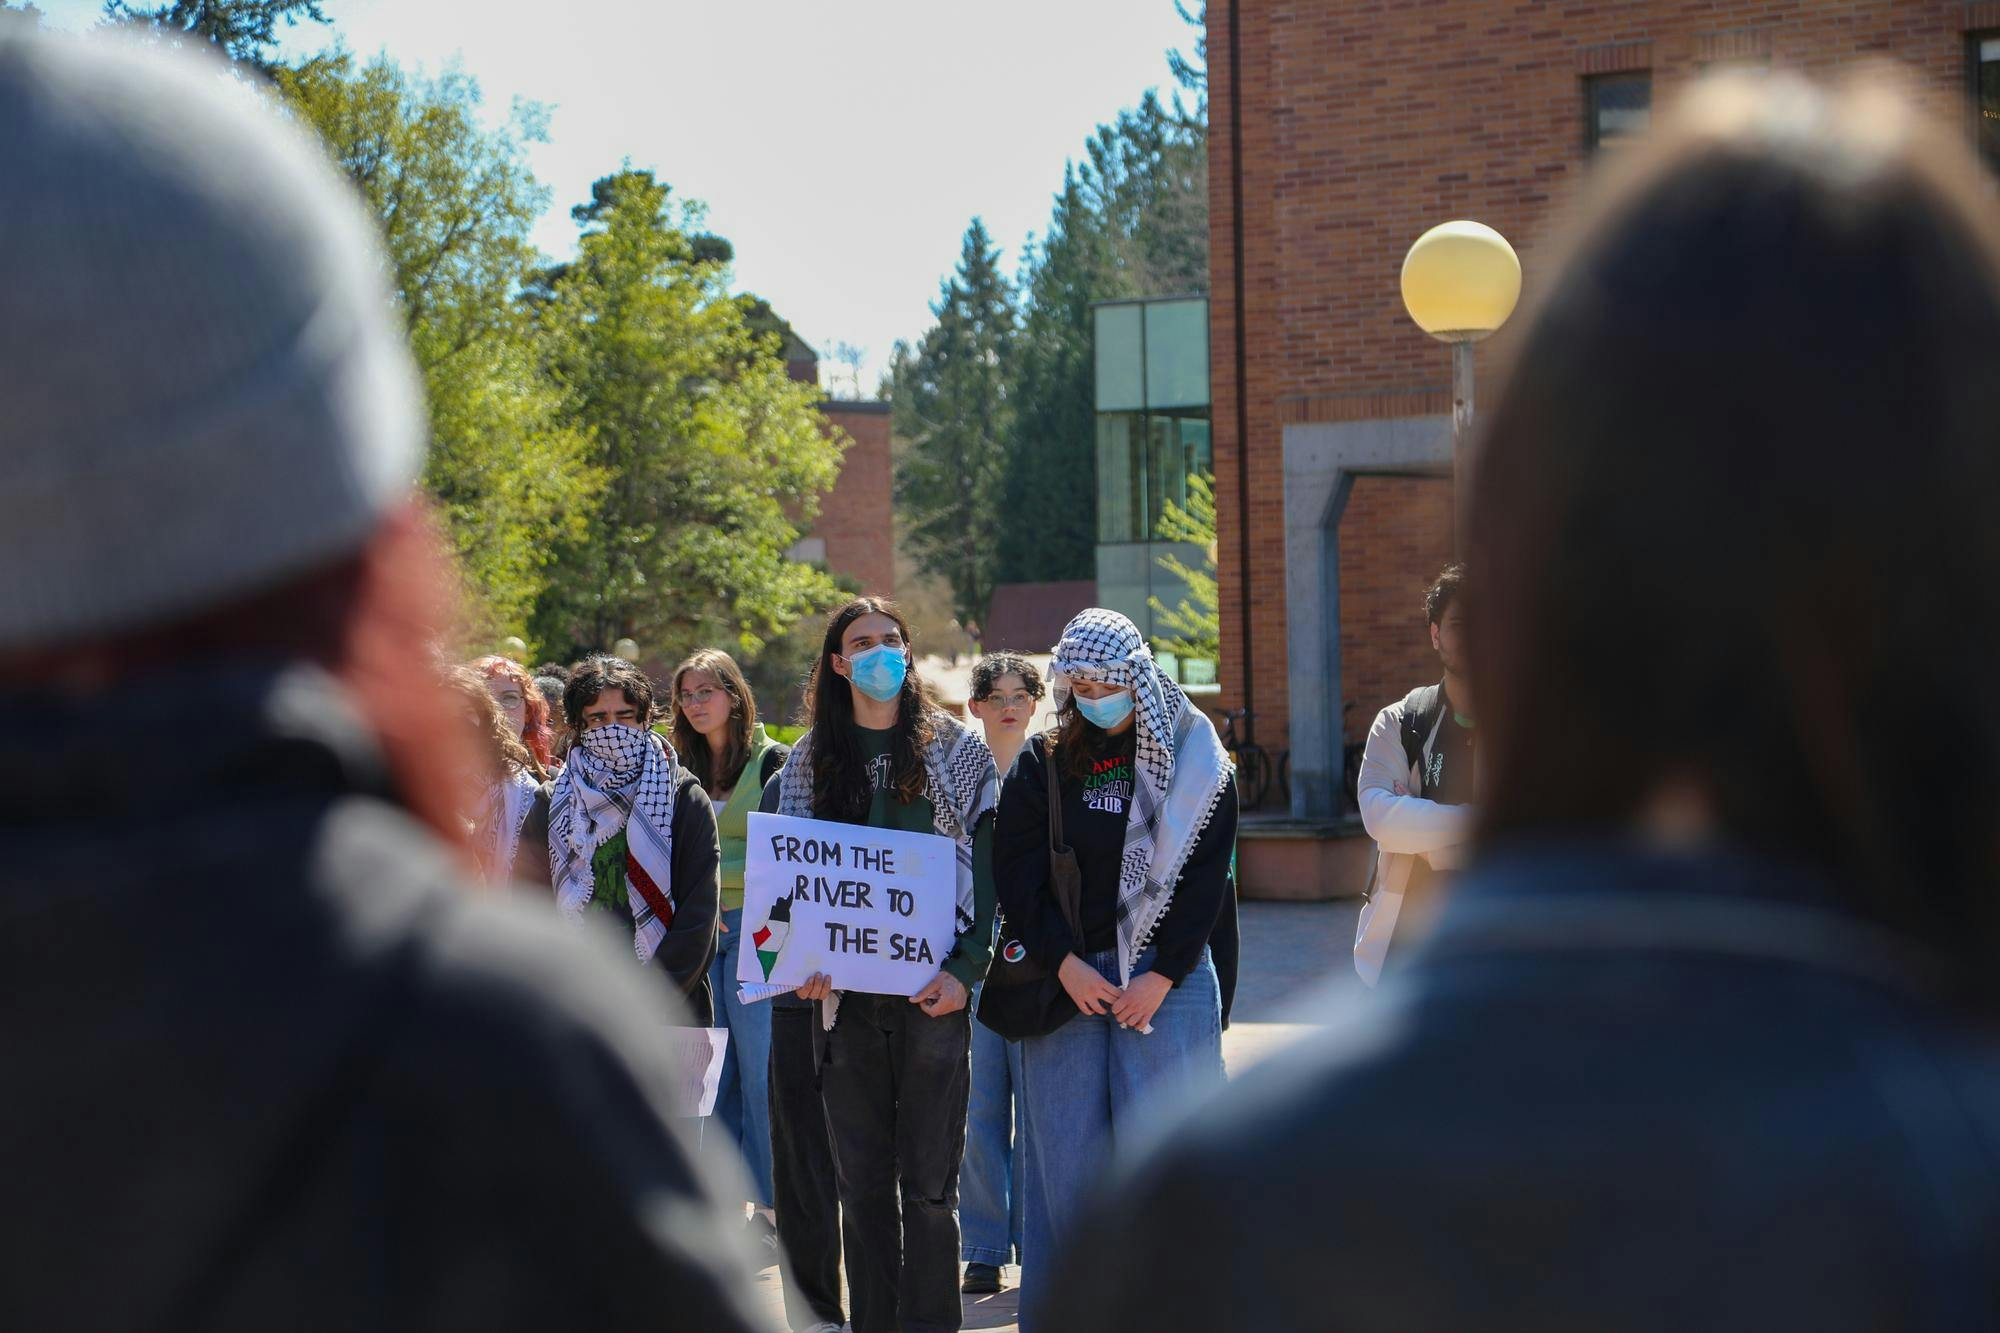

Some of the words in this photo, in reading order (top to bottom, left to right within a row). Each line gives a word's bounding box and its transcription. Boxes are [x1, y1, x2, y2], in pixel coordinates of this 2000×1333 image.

[1082, 780, 1132, 802] SOCIAL
[1088, 796, 1123, 814] CLUB
[771, 835, 842, 867] FROM
[850, 846, 895, 874] THE
[795, 875, 873, 908] RIVER
[887, 888, 914, 916] TO
[825, 922, 878, 954] THE
[889, 934, 934, 964] SEA
